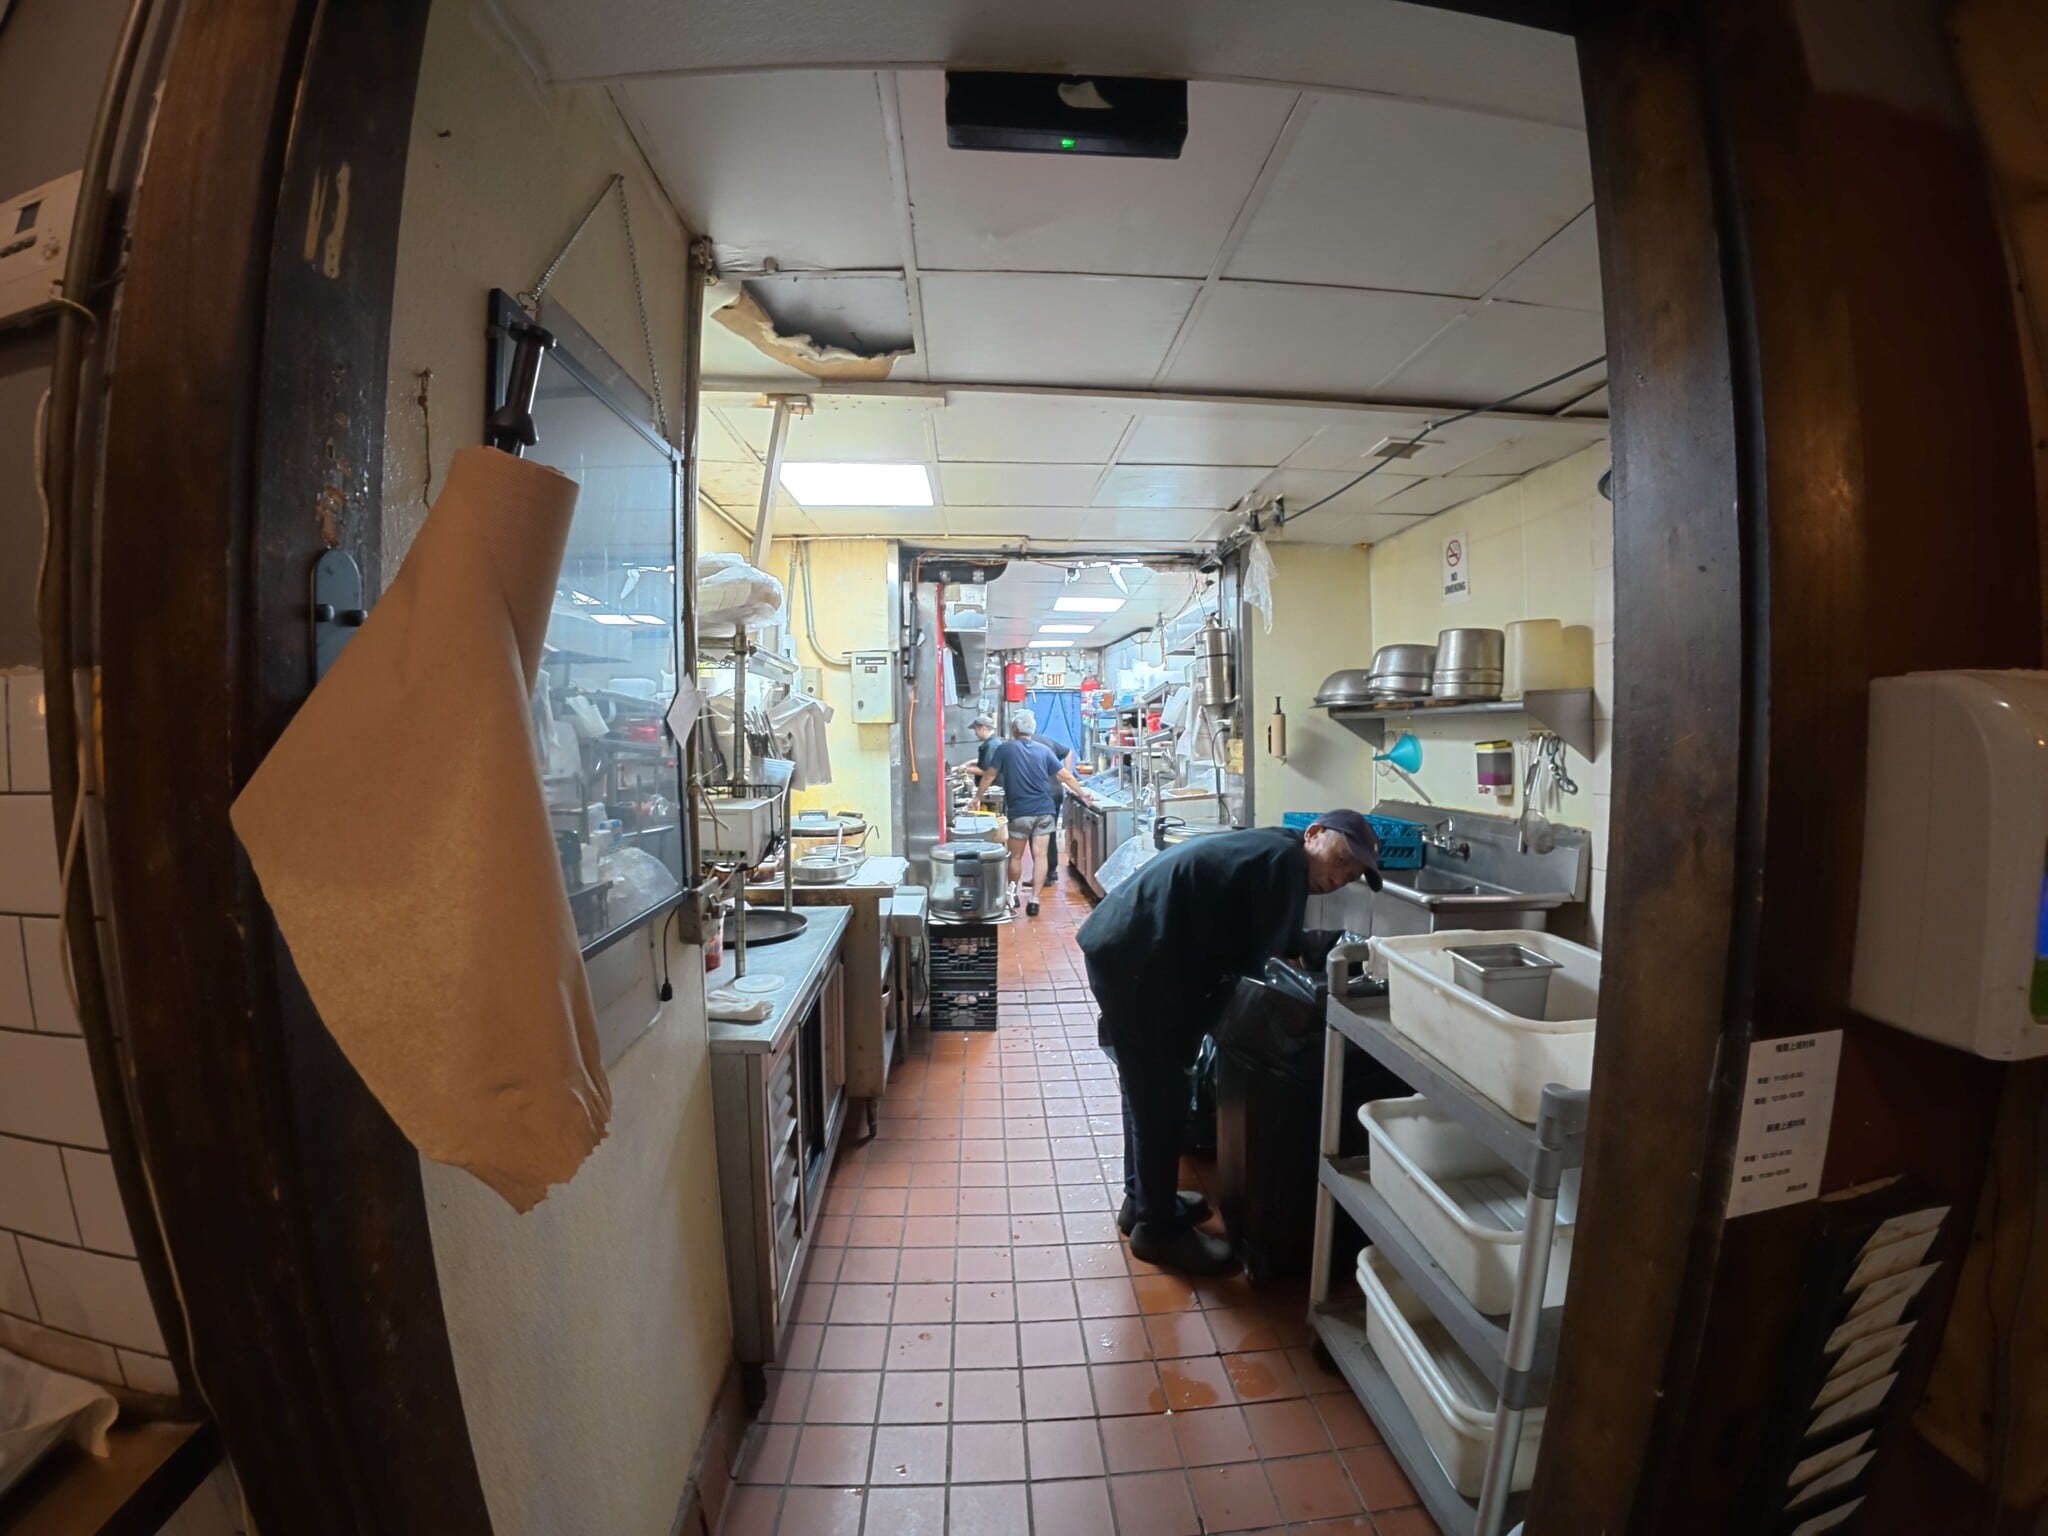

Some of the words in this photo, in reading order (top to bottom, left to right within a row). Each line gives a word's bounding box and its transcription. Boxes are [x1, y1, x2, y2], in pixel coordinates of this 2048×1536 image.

[1451, 572, 1457, 581] NO
[1445, 581, 1465, 594] SMOKING
[1047, 674, 1061, 685] EXIT
